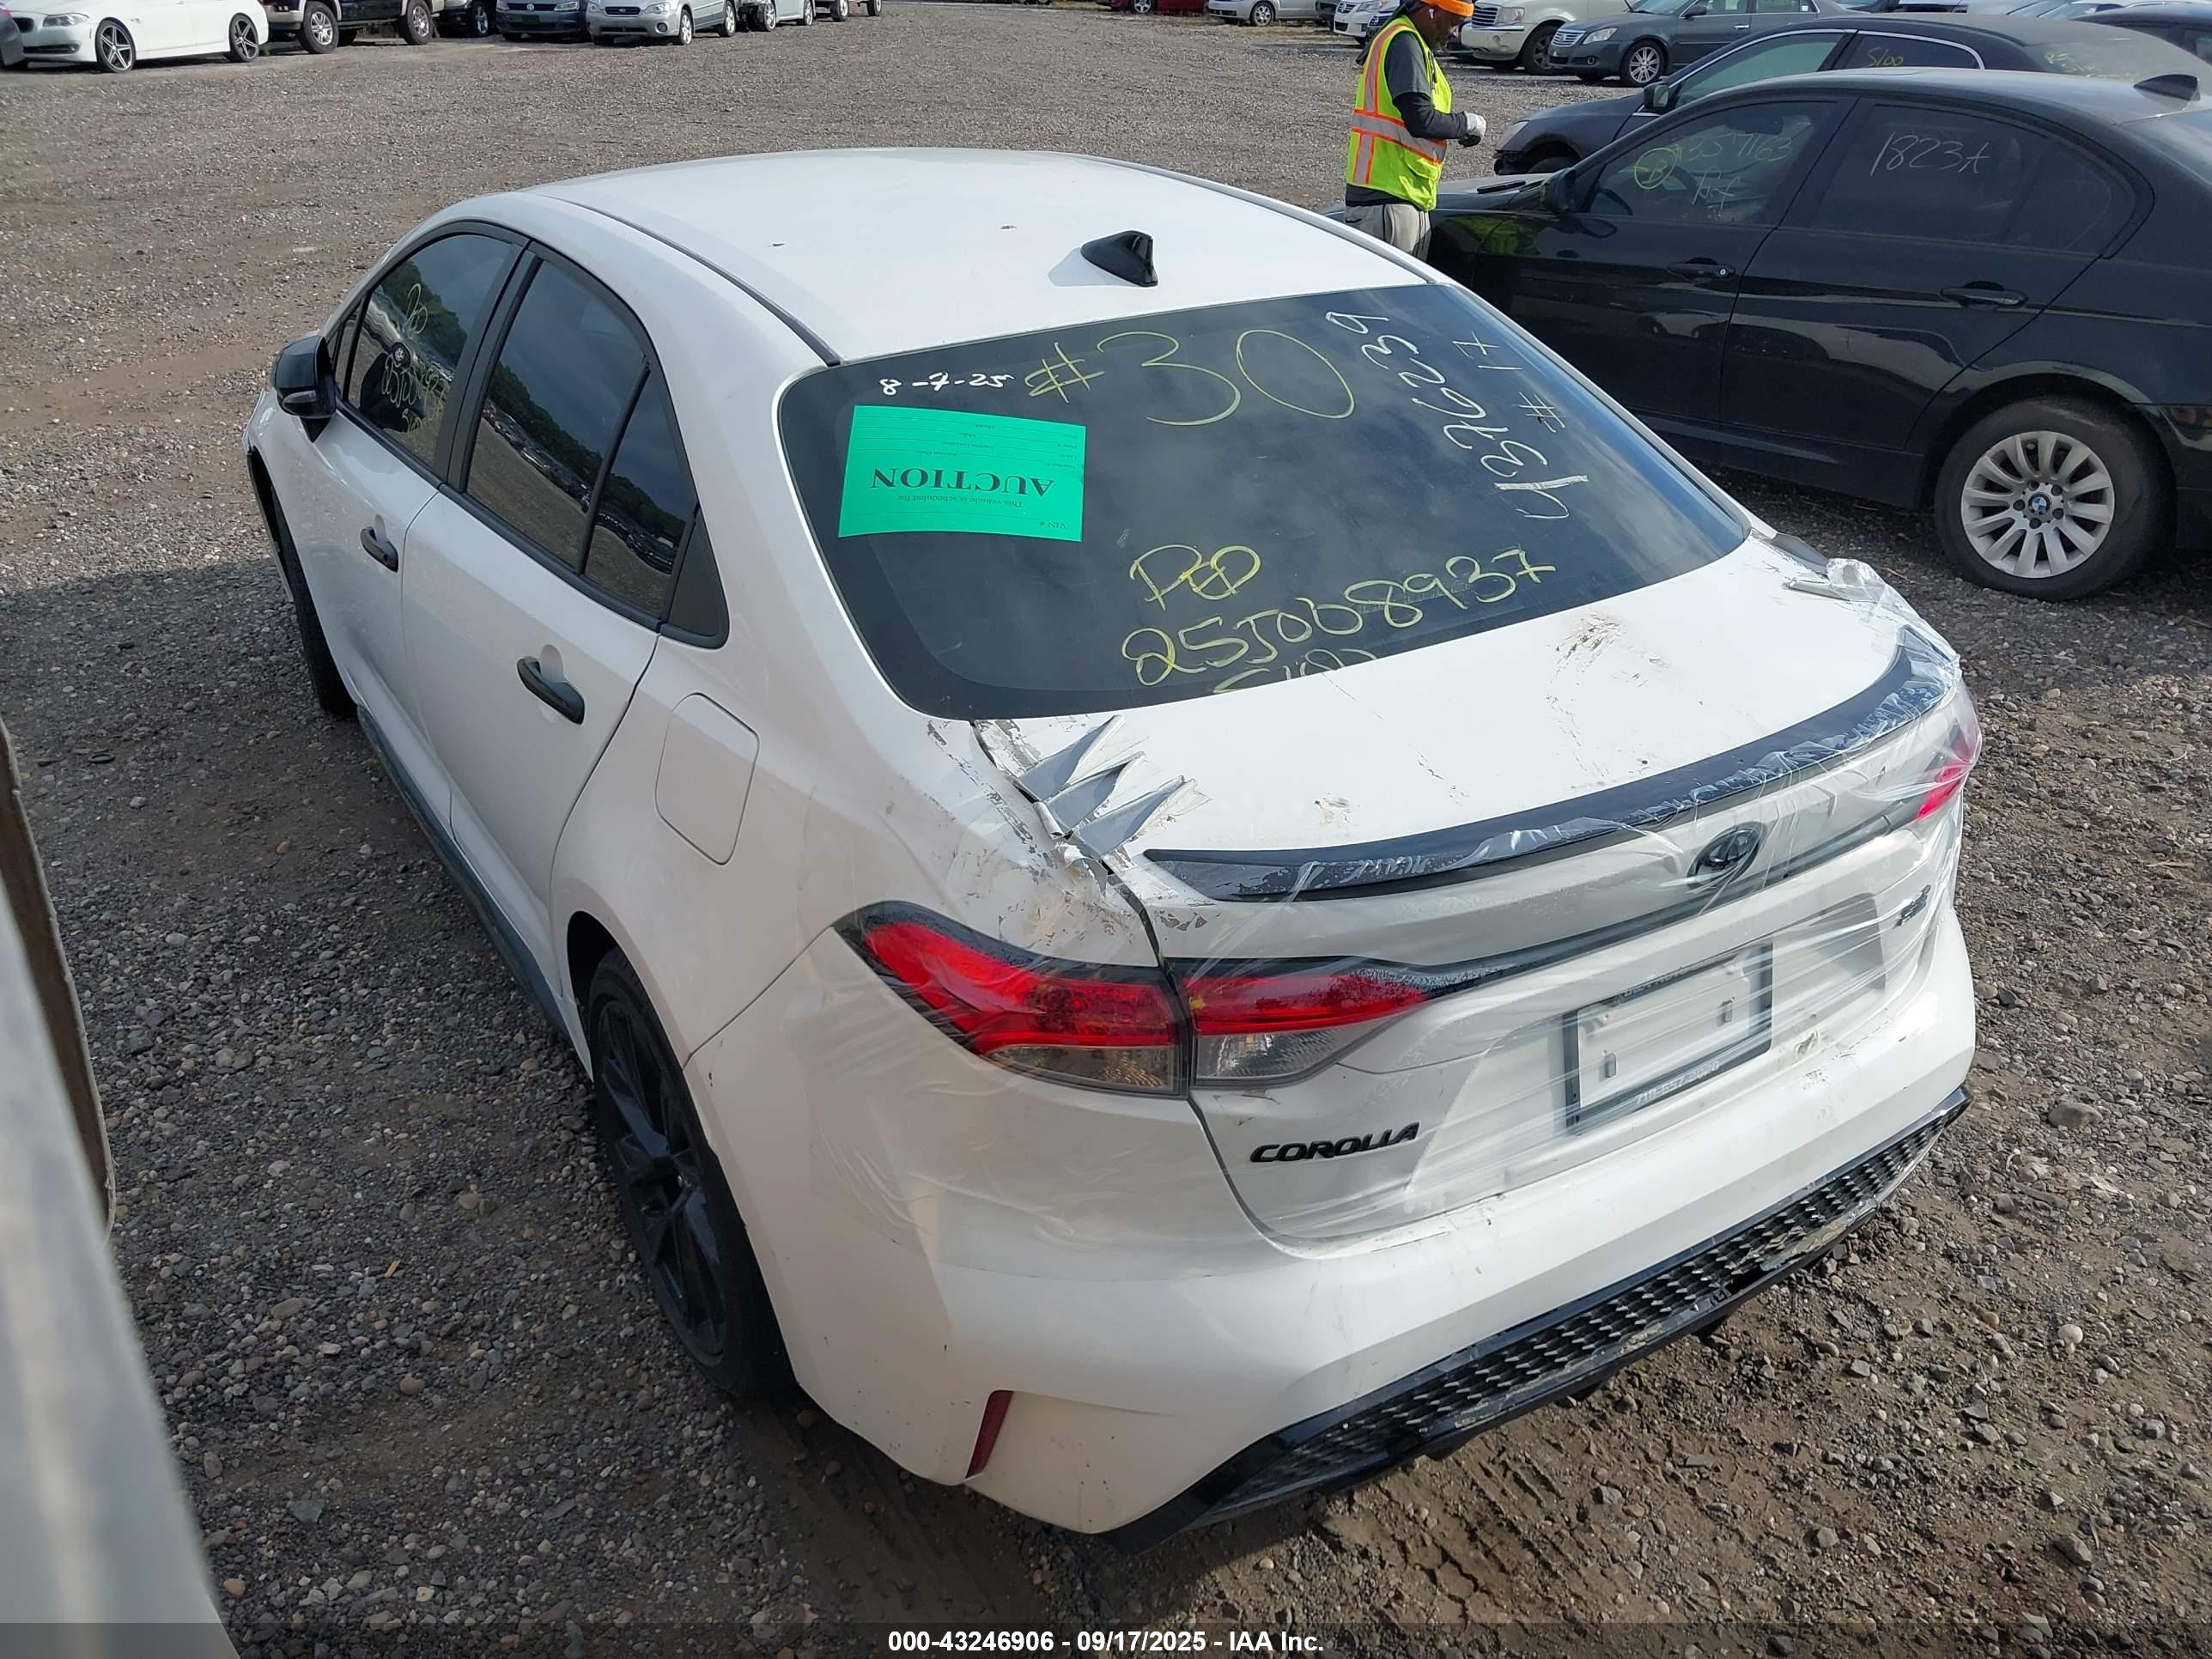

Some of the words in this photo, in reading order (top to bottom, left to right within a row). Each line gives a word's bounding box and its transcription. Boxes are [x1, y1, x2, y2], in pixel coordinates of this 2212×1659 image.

[879, 371, 1014, 396] 8-7-25
[869, 467, 1055, 497] AUCTION
[912, 495, 957, 503] scheduled
[969, 497, 1002, 507] vehicle
[1004, 500, 1024, 508] This
[1048, 520, 1069, 530] VIN
[1249, 1121, 1420, 1163] COROLLA
